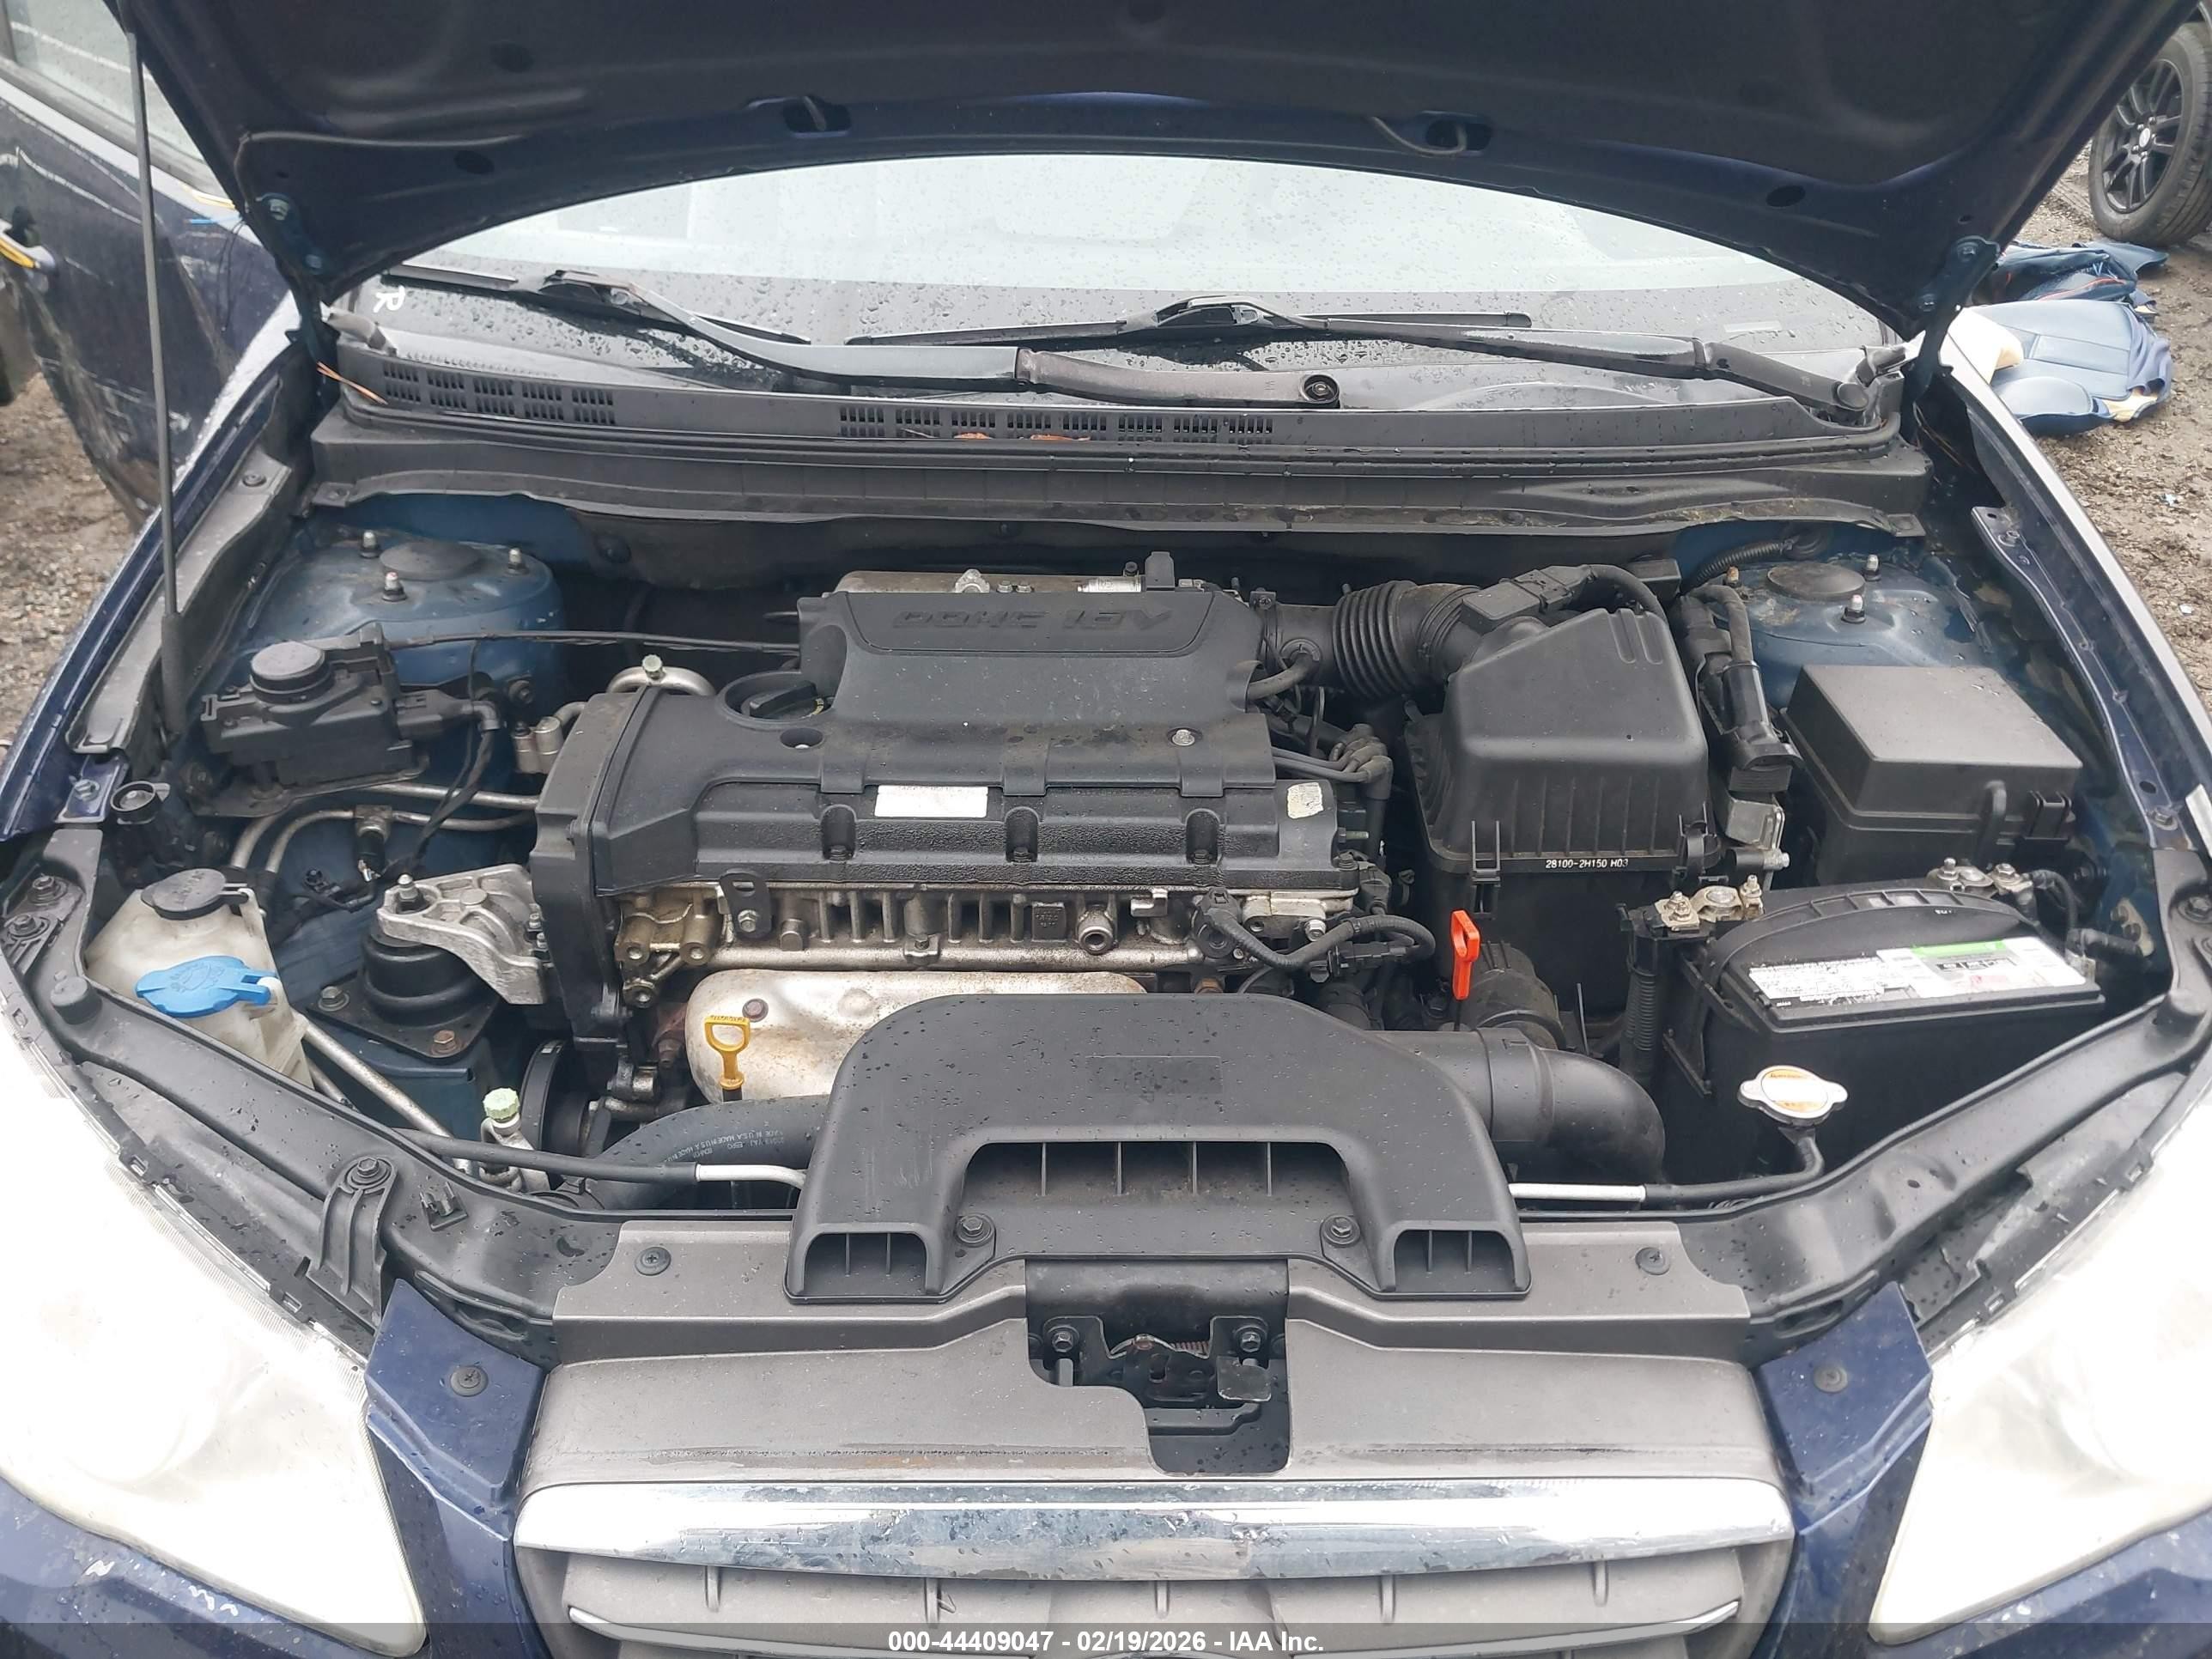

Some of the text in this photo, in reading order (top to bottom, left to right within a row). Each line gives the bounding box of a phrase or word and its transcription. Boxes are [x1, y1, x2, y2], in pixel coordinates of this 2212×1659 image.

[892, 609, 1173, 631] DOHC 16V
[1545, 859, 1607, 869] 28100-2H150
